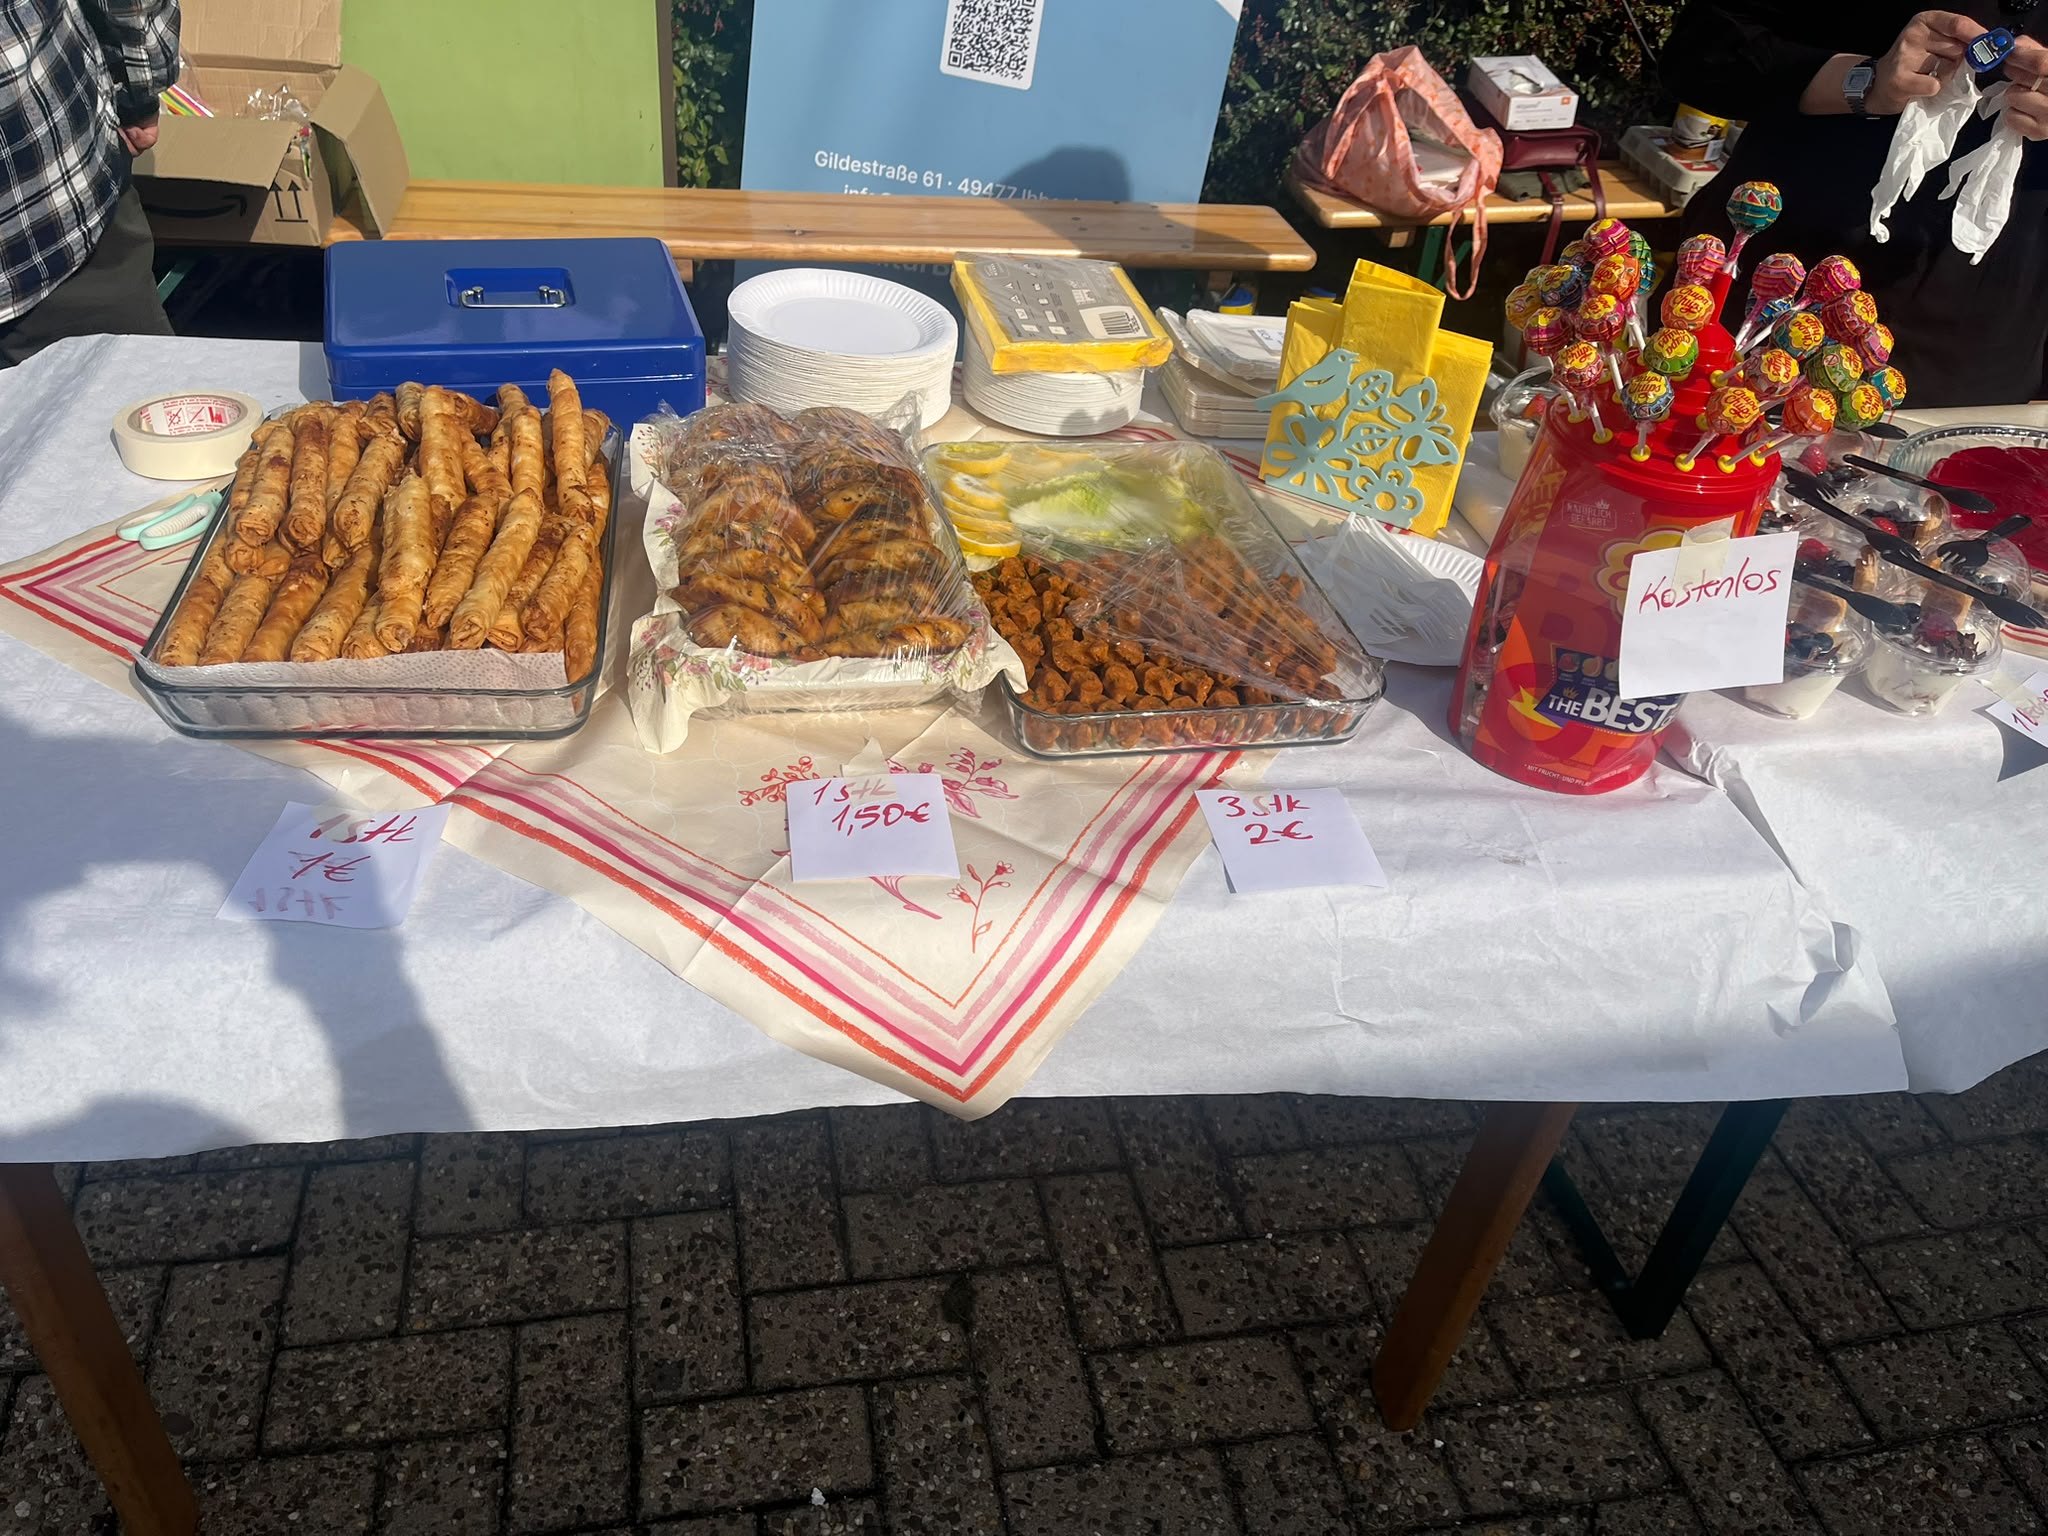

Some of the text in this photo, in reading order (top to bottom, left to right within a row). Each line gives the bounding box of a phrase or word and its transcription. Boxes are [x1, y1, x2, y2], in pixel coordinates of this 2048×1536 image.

[814, 149, 919, 185] Gildestraße
[922, 170, 943, 190] 61
[957, 177, 1017, 200] 49477
[1673, 294, 1703, 315] Chups
[1724, 394, 1751, 419] Chups
[1732, 388, 1758, 412] Chupa
[1639, 556, 1782, 614] Kostenlos
[1549, 693, 1582, 717] THE
[1580, 687, 1678, 733] BEST
[813, 779, 832, 805] 1
[1217, 795, 1246, 817] 3
[831, 802, 930, 836] 1,50€
[1244, 820, 1314, 845] 2€
